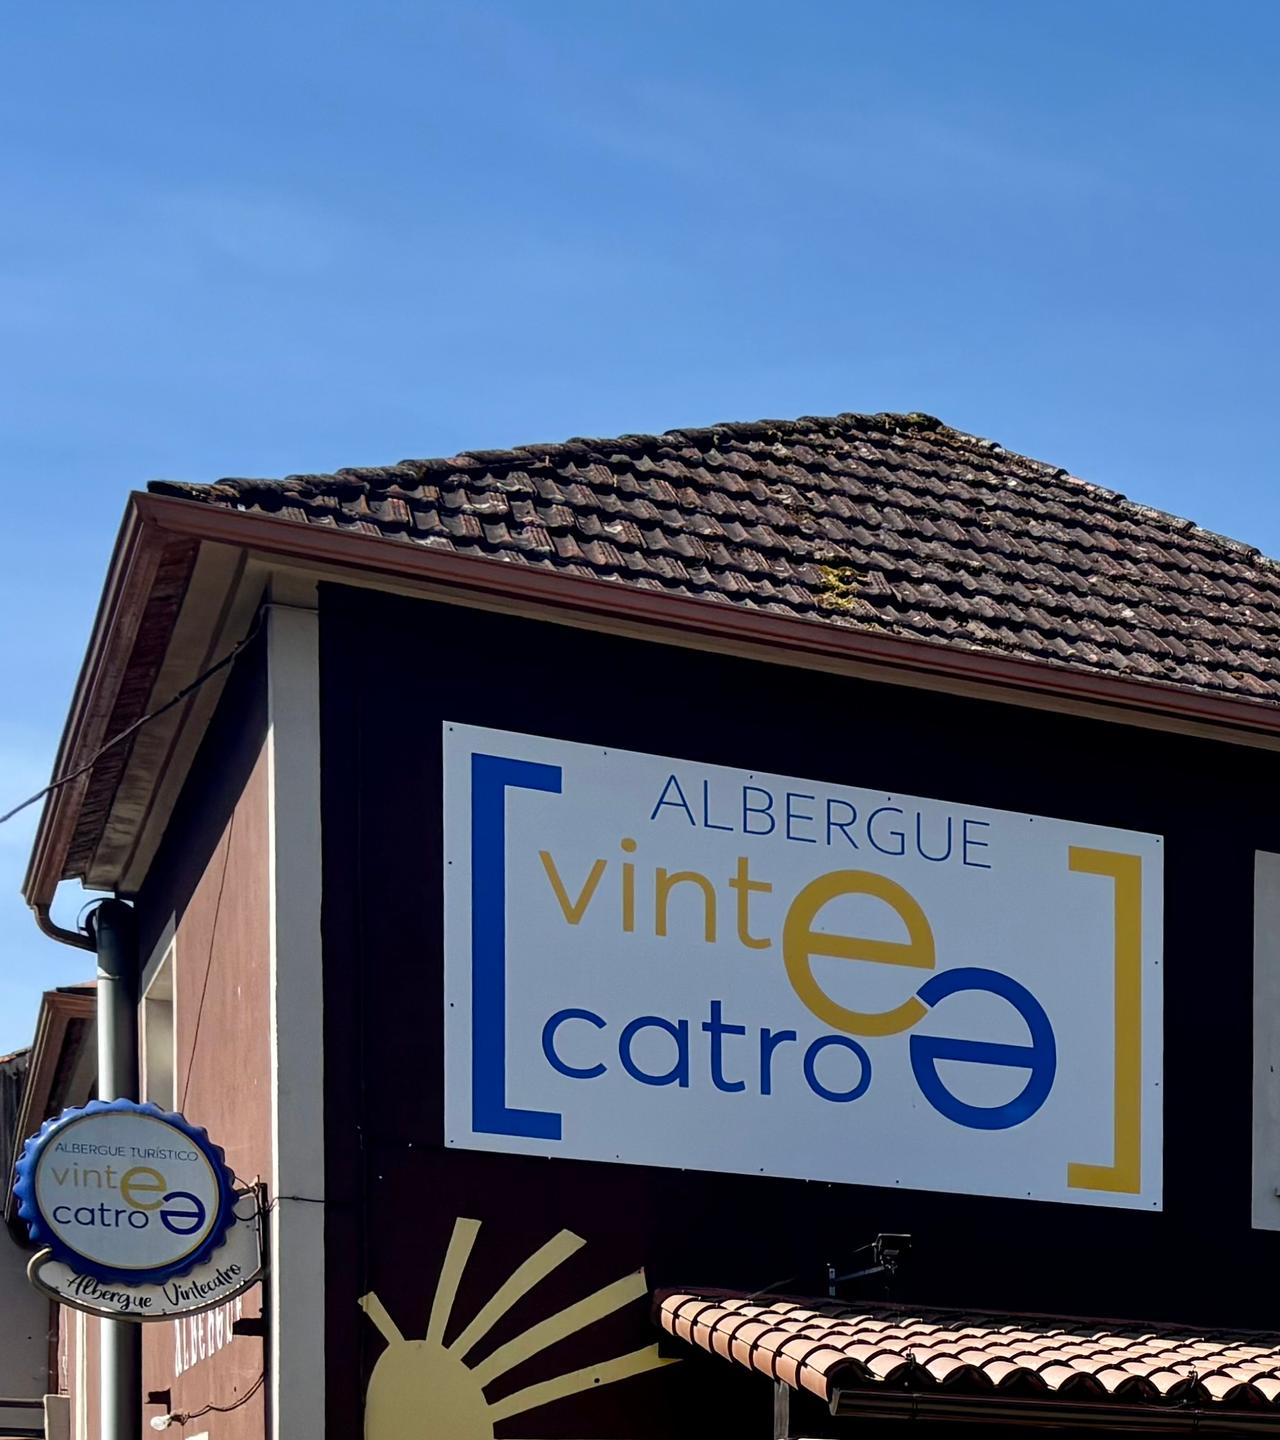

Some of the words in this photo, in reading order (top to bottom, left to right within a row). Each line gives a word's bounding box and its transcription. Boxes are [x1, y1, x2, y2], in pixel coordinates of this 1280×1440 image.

[650, 774, 993, 869] ALBERGUE
[541, 1000, 873, 1104] catro
[55, 1142, 126, 1157] ALBERGUE
[130, 1146, 199, 1162] TURÍSTICO
[52, 1203, 149, 1229] catro
[66, 1274, 153, 1310] Albergue
